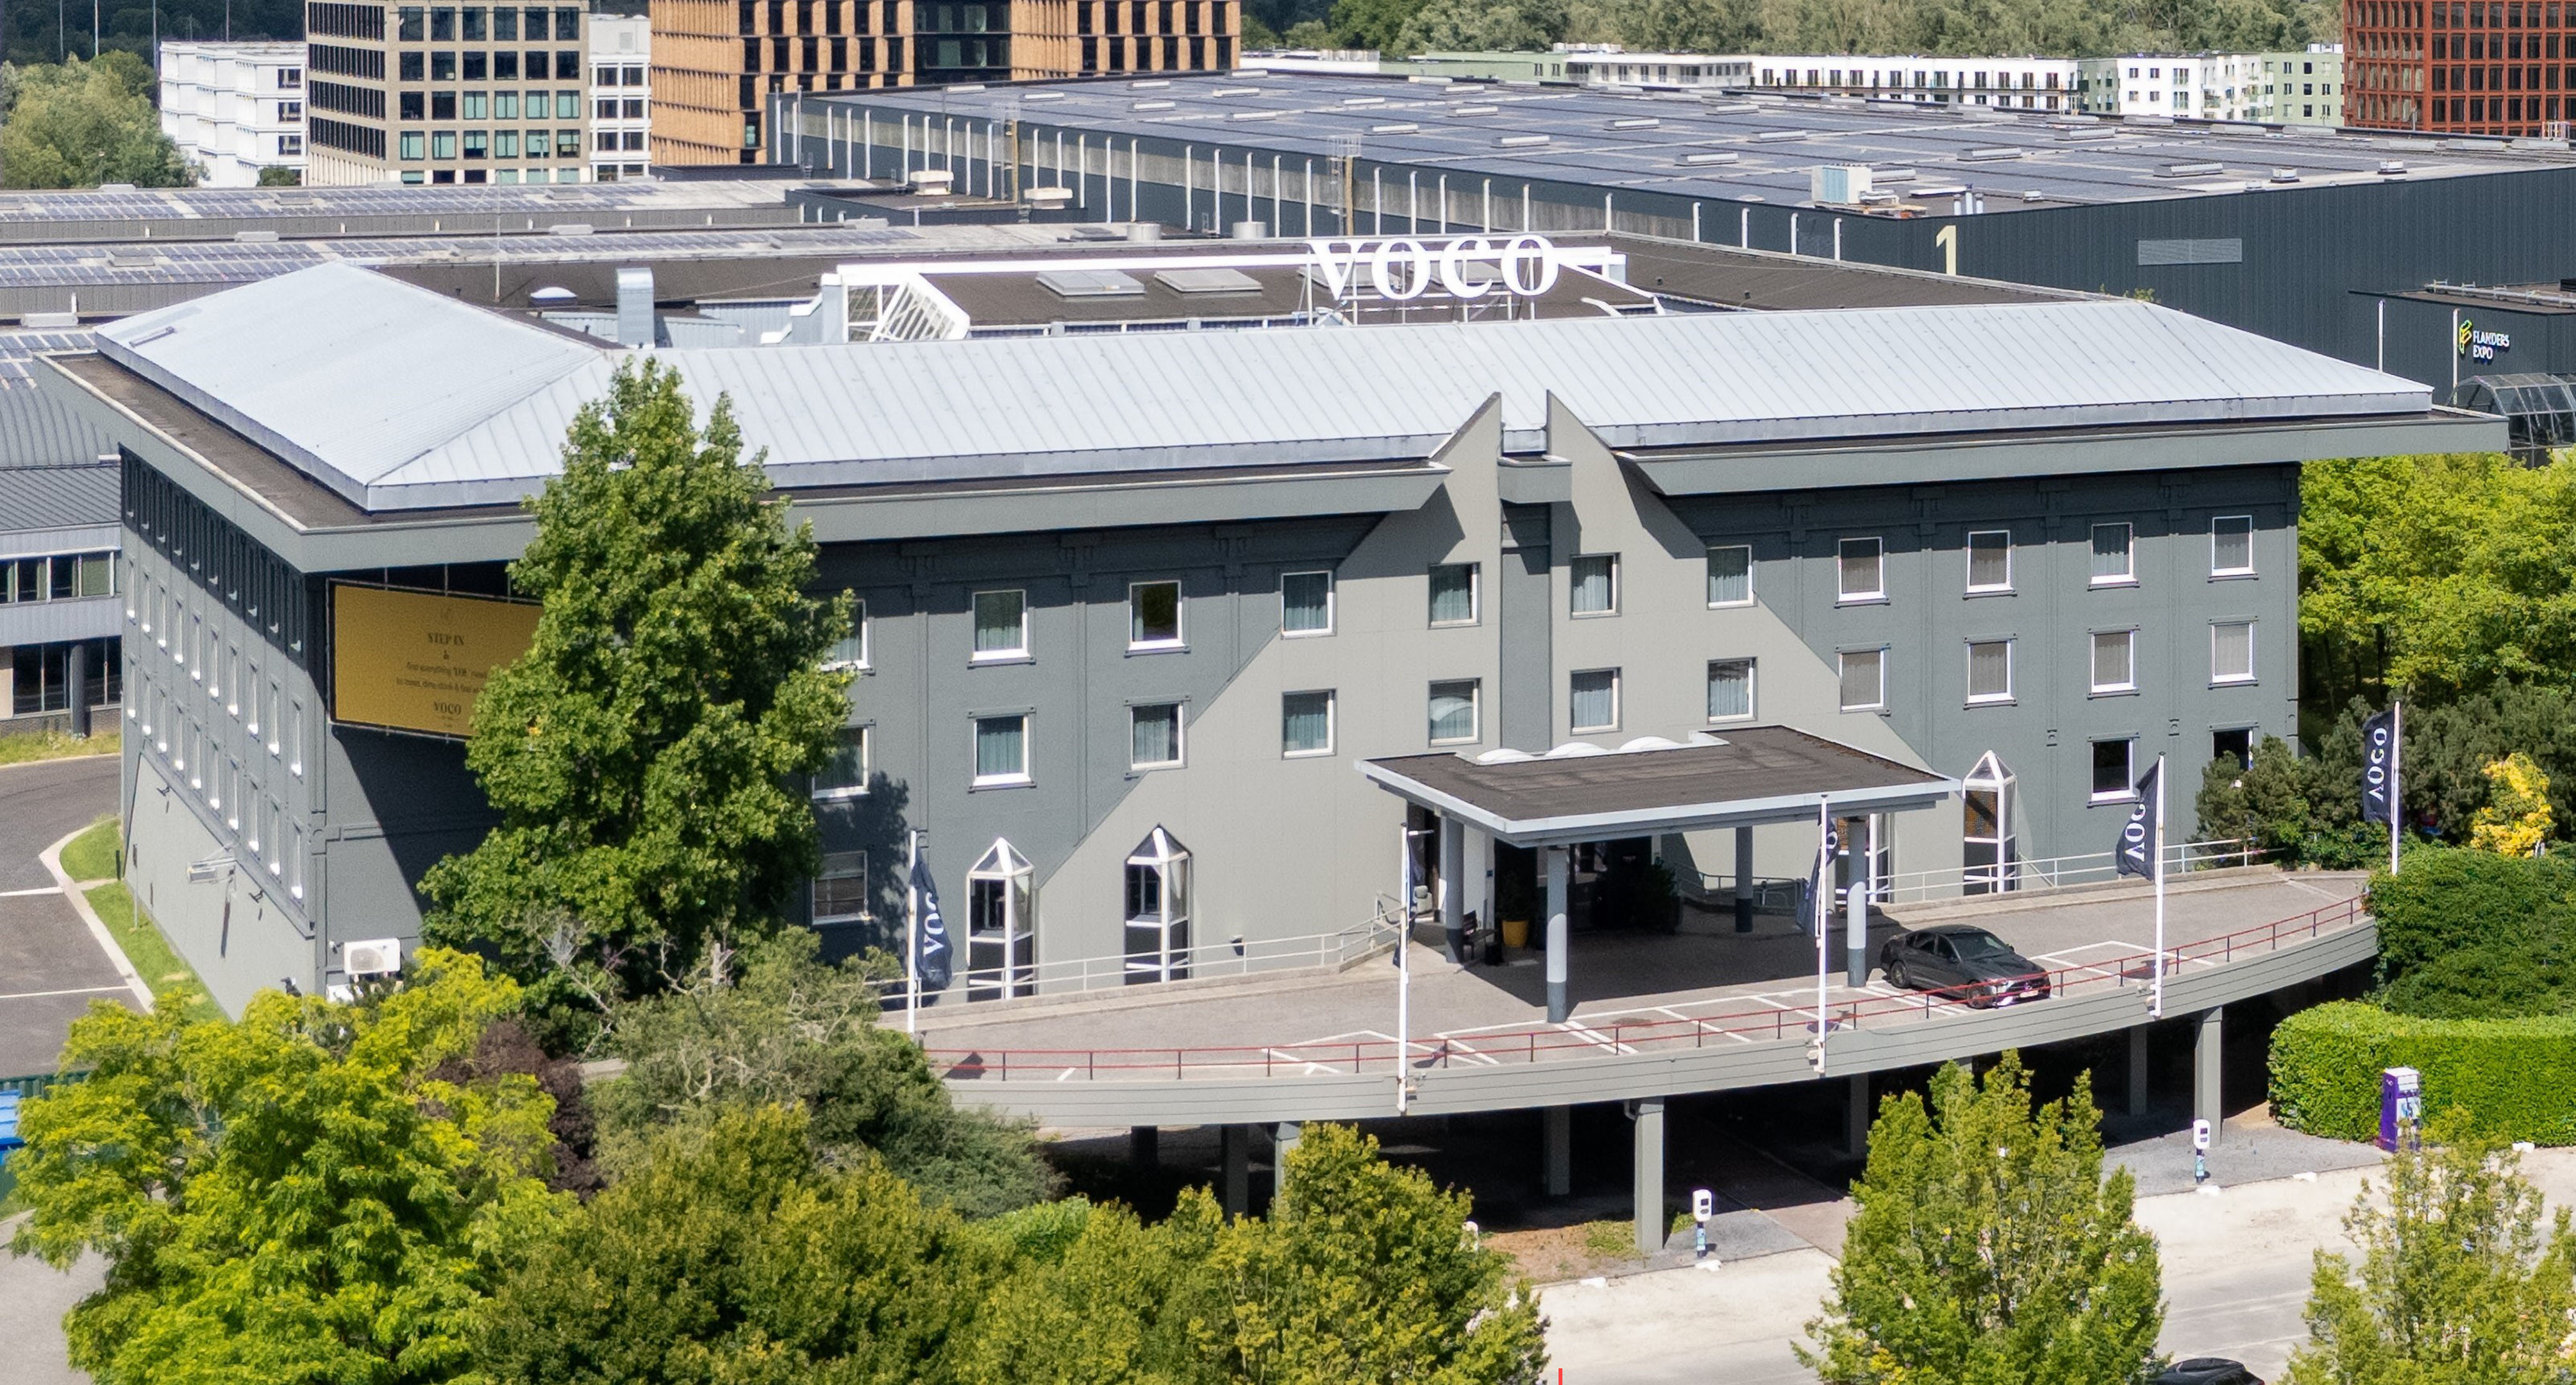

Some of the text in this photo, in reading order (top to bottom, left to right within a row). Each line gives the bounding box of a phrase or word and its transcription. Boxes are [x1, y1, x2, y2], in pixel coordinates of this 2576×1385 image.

[1936, 224, 1957, 276] 1
[2473, 330, 2510, 347] FLANDERS
[2473, 344, 2493, 360] EXPO
